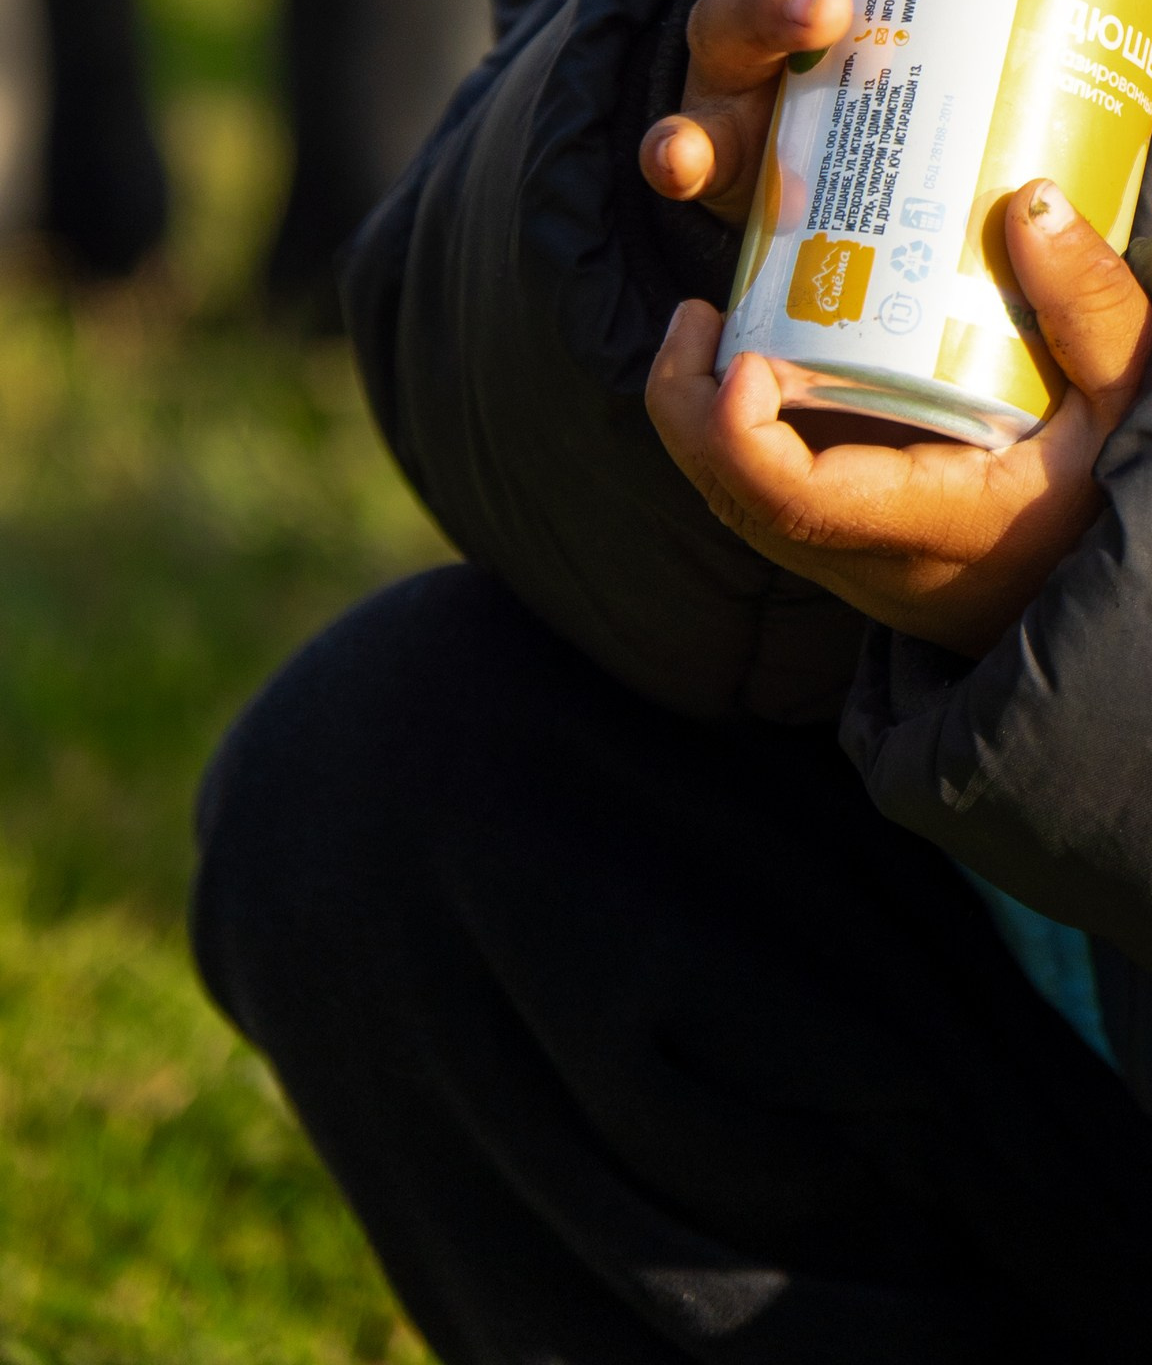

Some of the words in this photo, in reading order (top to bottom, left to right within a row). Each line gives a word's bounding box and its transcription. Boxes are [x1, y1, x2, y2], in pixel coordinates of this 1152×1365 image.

[863, 0, 876, 23] +992
[839, 52, 856, 87] ГРУПП»,
[863, 79, 874, 90] 13.
[909, 64, 921, 76] 13.
[830, 89, 846, 128] «АВЕСТО
[849, 93, 871, 155] ИСТАРАВШАН
[896, 81, 918, 145] ИСТАРАВШАН
[825, 130, 837, 148] ООО
[845, 141, 874, 231] ИСТЕҲСОЛКУНАНДА:
[873, 68, 890, 107] «АВЕСТО
[819, 171, 840, 230] РЕСПУБЛИКА
[833, 100, 858, 168] ТАДЖИКИСТАН,
[845, 158, 857, 171] УЛ.
[806, 151, 832, 230] ПРОИЗВОДИТЕЛЬ:
[834, 175, 854, 222] ДУШАНБЕ,
[877, 171, 898, 221] ДУШАНБЕ,
[873, 223, 885, 235] Ш.
[820, 250, 850, 313] Сиёма
